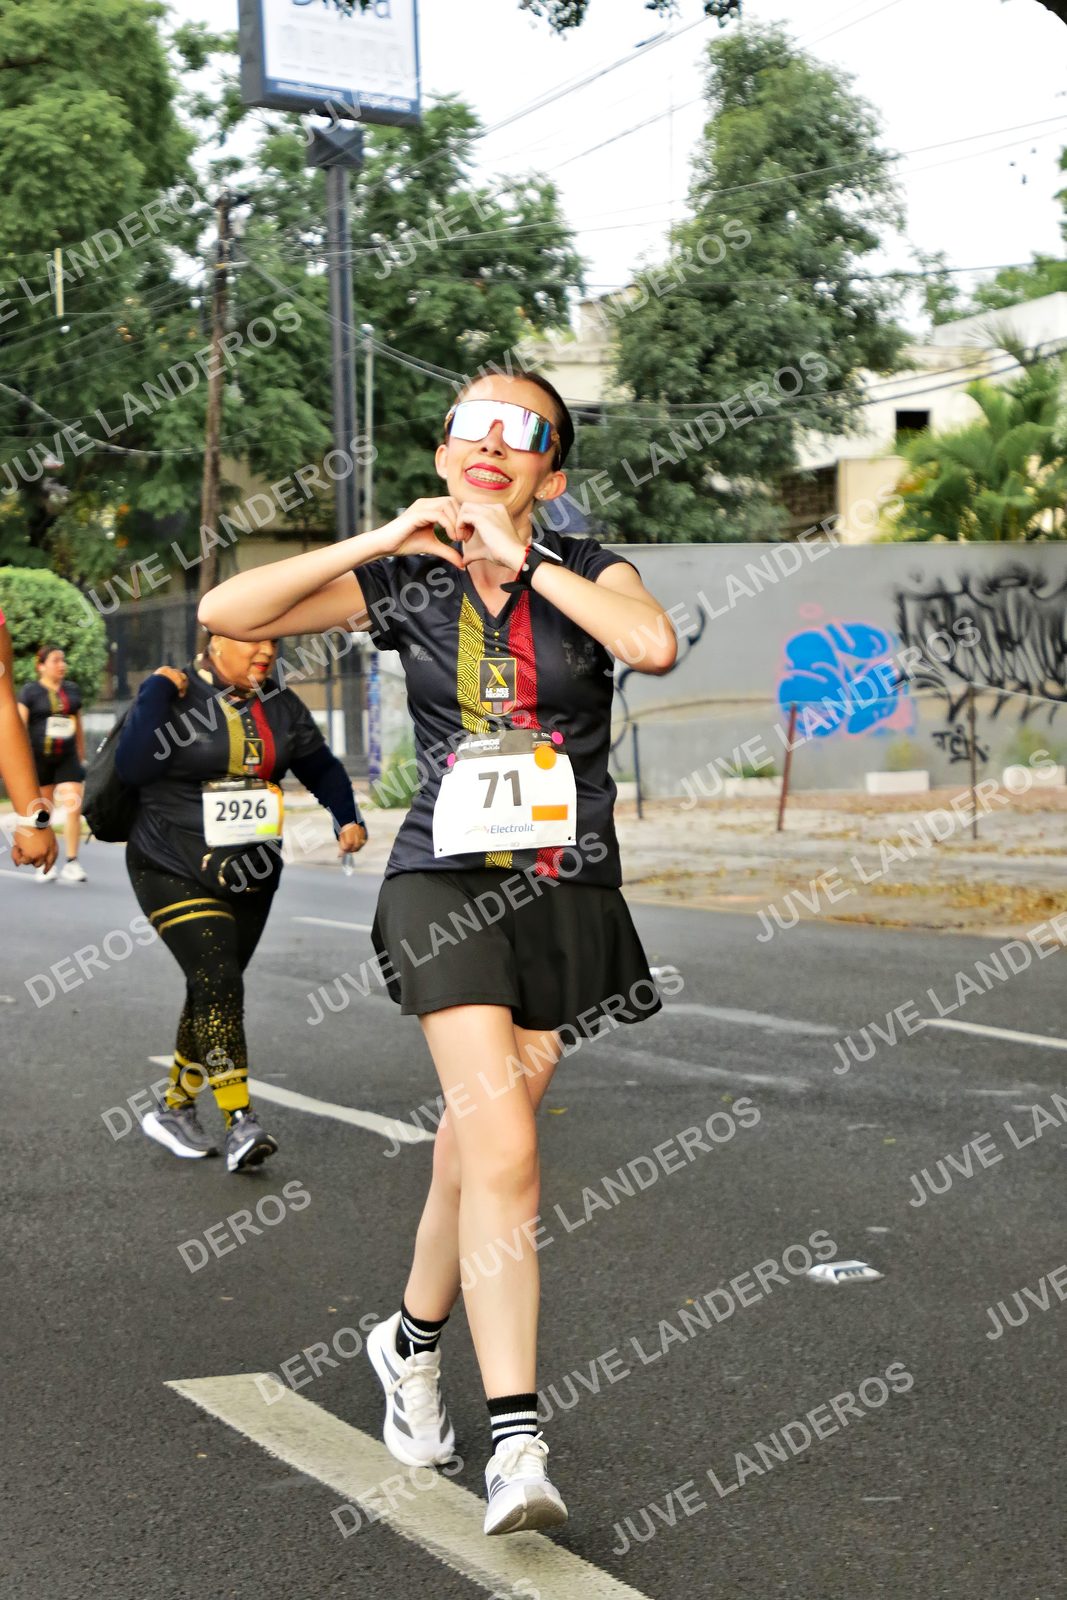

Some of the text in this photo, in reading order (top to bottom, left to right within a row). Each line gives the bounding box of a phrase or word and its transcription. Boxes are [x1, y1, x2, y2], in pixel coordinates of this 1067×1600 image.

[477, 769, 523, 809] 71
[215, 798, 267, 822] 2926
[489, 821, 536, 834] Electrolit
